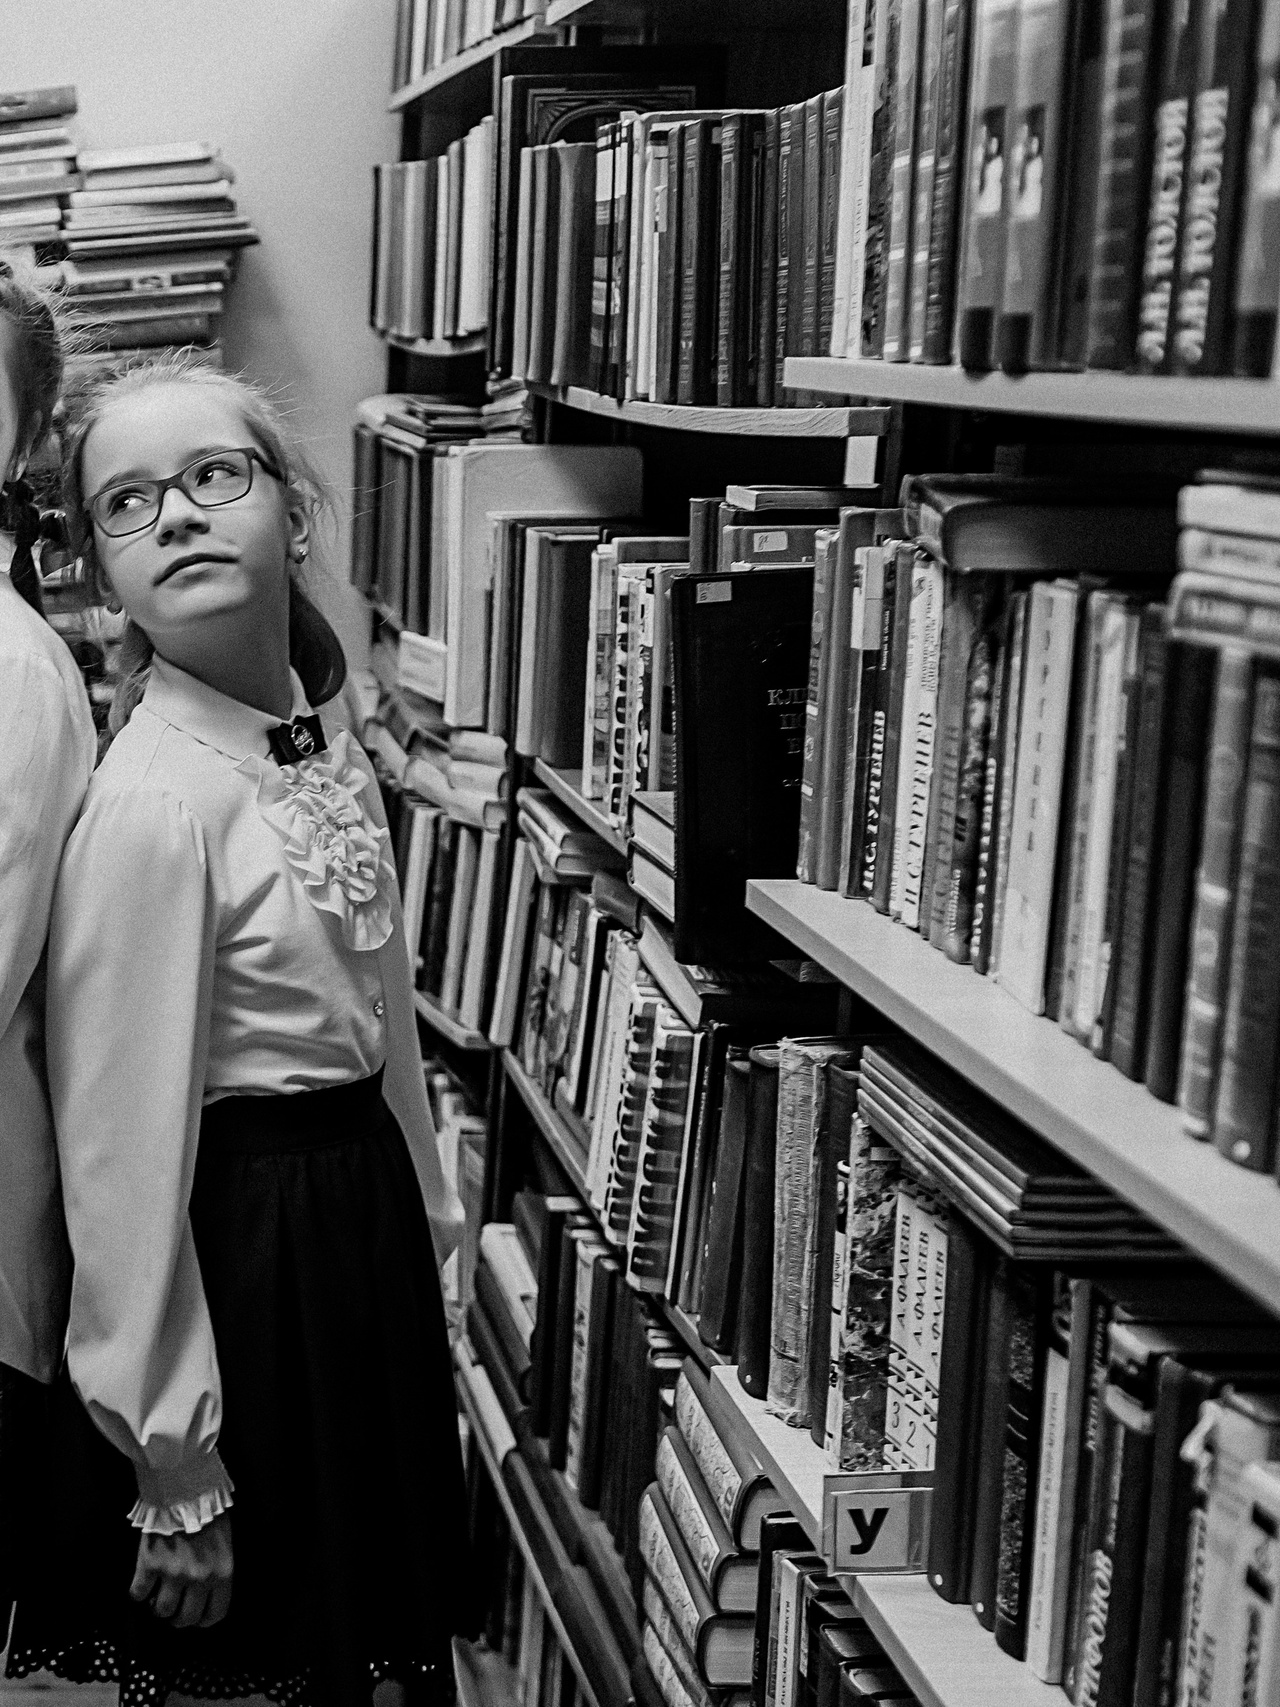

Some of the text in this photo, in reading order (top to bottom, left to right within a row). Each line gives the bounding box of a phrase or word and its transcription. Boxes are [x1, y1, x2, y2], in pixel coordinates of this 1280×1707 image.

[866, 709, 886, 835] ТУРГЕНЕВ
[908, 711, 932, 849] ТУРГЕНЕВ
[890, 1401, 901, 1429] 3
[903, 1420, 916, 1448] 2
[846, 1506, 890, 1555] У
